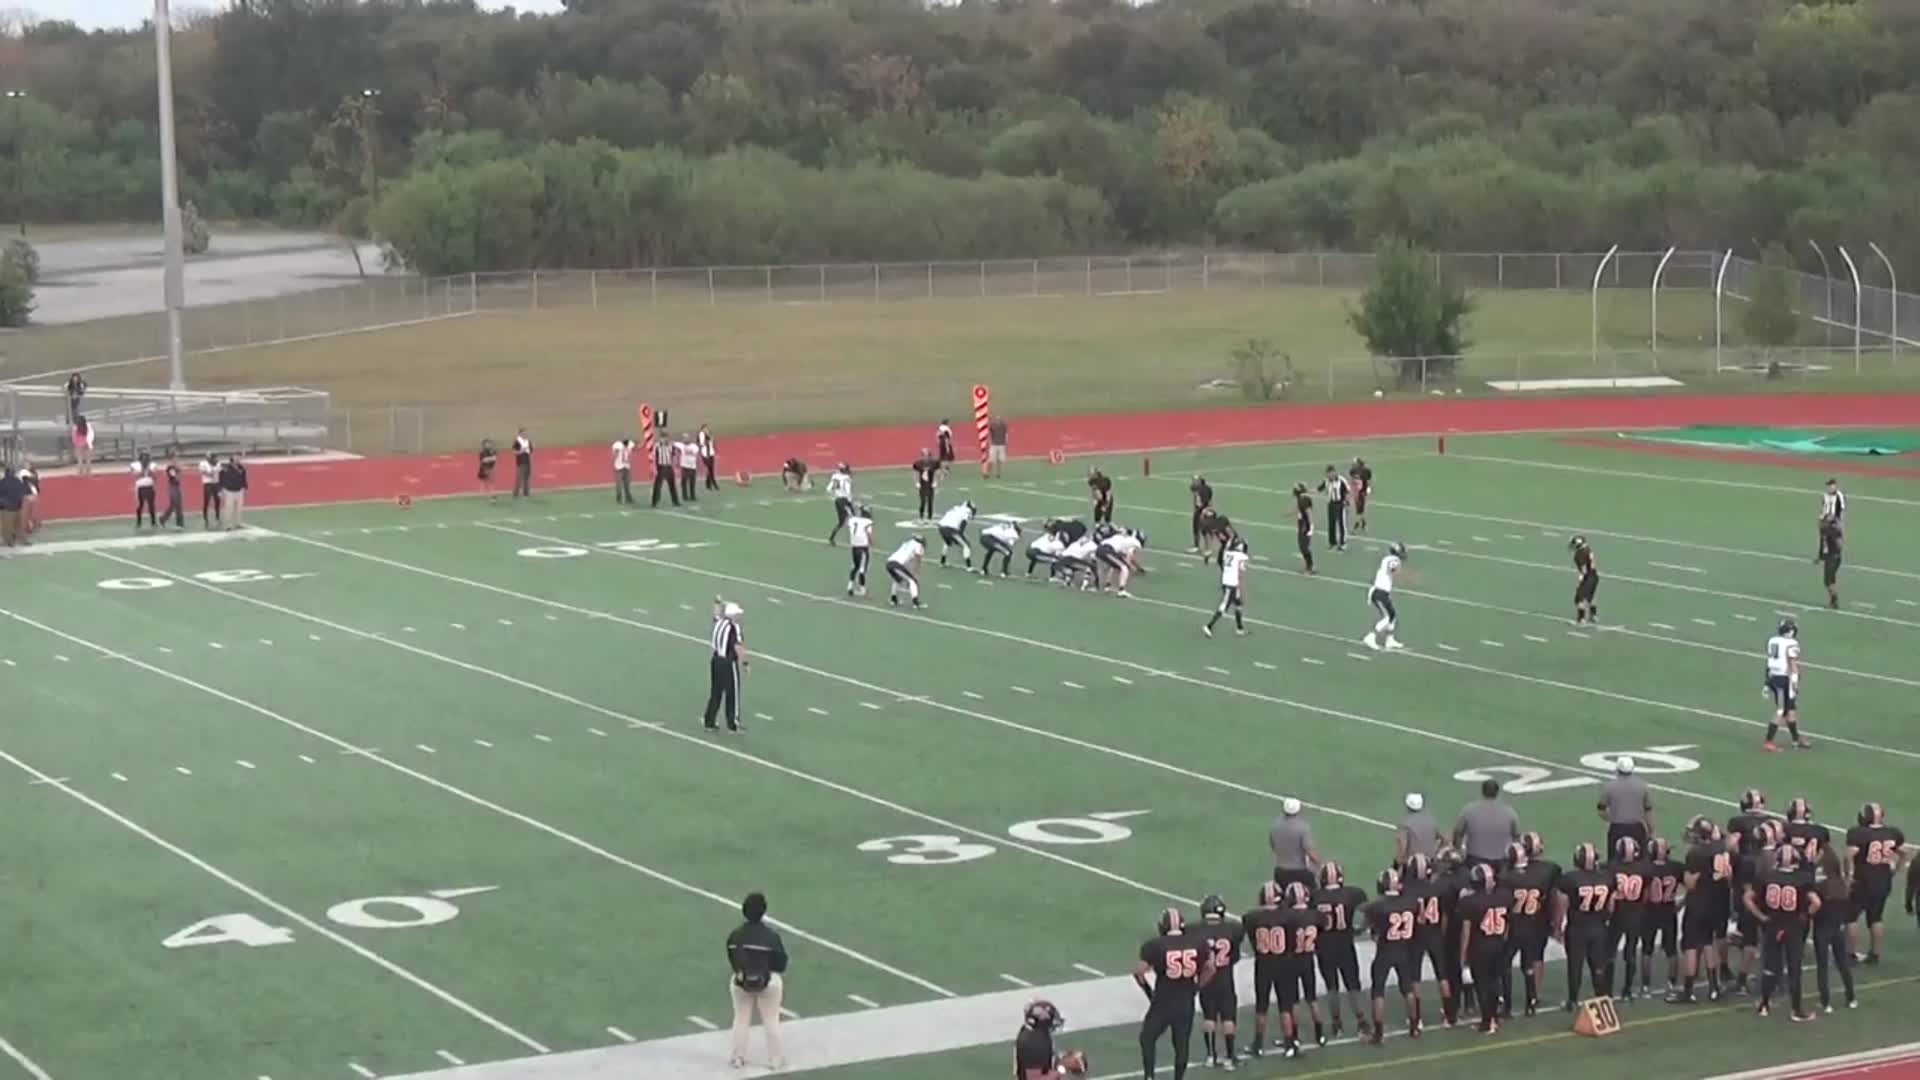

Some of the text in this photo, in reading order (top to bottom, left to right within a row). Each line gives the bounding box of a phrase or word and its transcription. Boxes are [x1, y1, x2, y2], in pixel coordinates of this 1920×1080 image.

[857, 817, 1132, 865] 30
[1513, 888, 1542, 915] 76
[1578, 885, 1608, 912] 77
[162, 895, 460, 948] 40
[1387, 911, 1414, 940] 23
[1479, 907, 1508, 935] 45
[1166, 948, 1198, 979] 55
[1589, 999, 1617, 1031] 30
